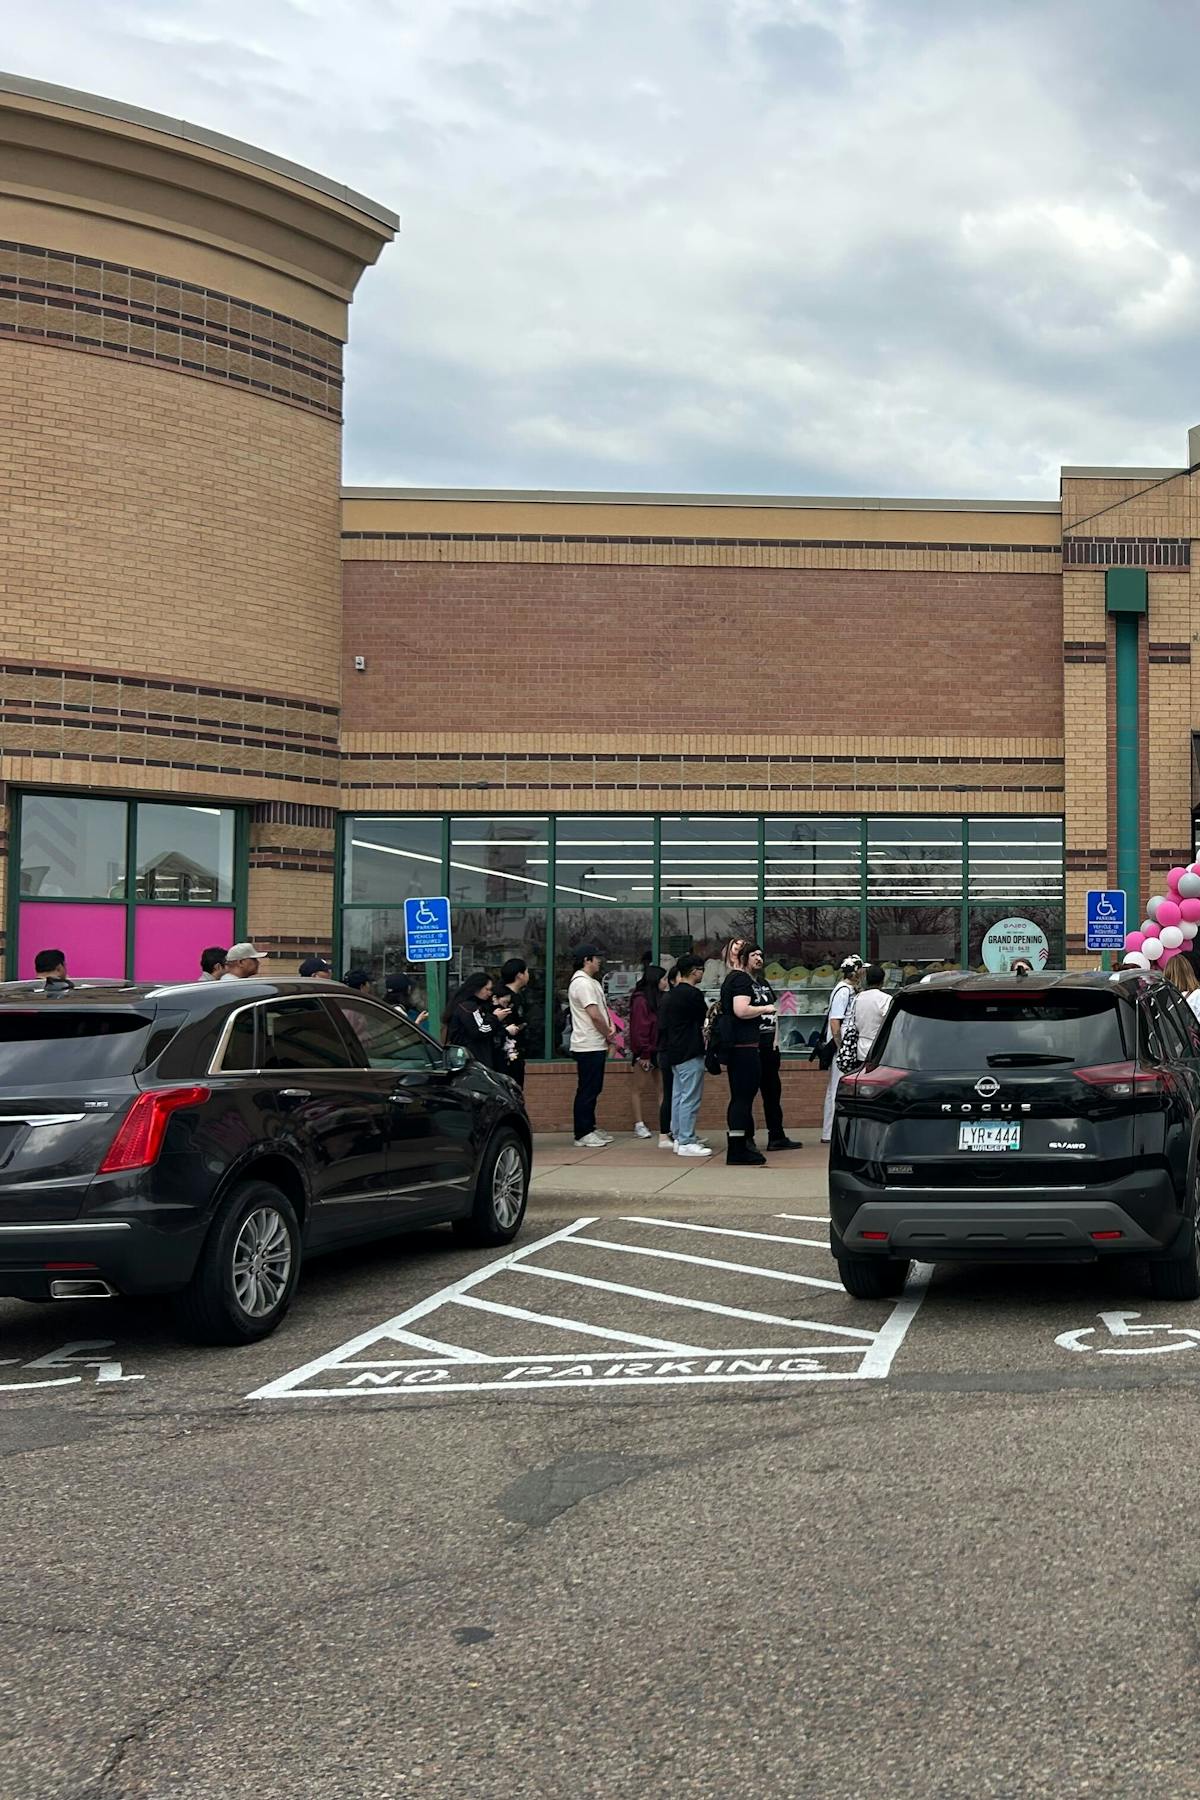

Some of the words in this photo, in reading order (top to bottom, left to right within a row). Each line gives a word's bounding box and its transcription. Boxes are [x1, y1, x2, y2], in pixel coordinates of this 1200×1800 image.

[988, 935, 1012, 944] GRAND
[1013, 935, 1043, 944] OPENING
[941, 1103, 1032, 1112] ROGUE
[962, 1127, 986, 1144] LYR
[995, 1127, 1018, 1144] 444
[347, 1368, 451, 1387] NO
[502, 1357, 829, 1382] PARKING
